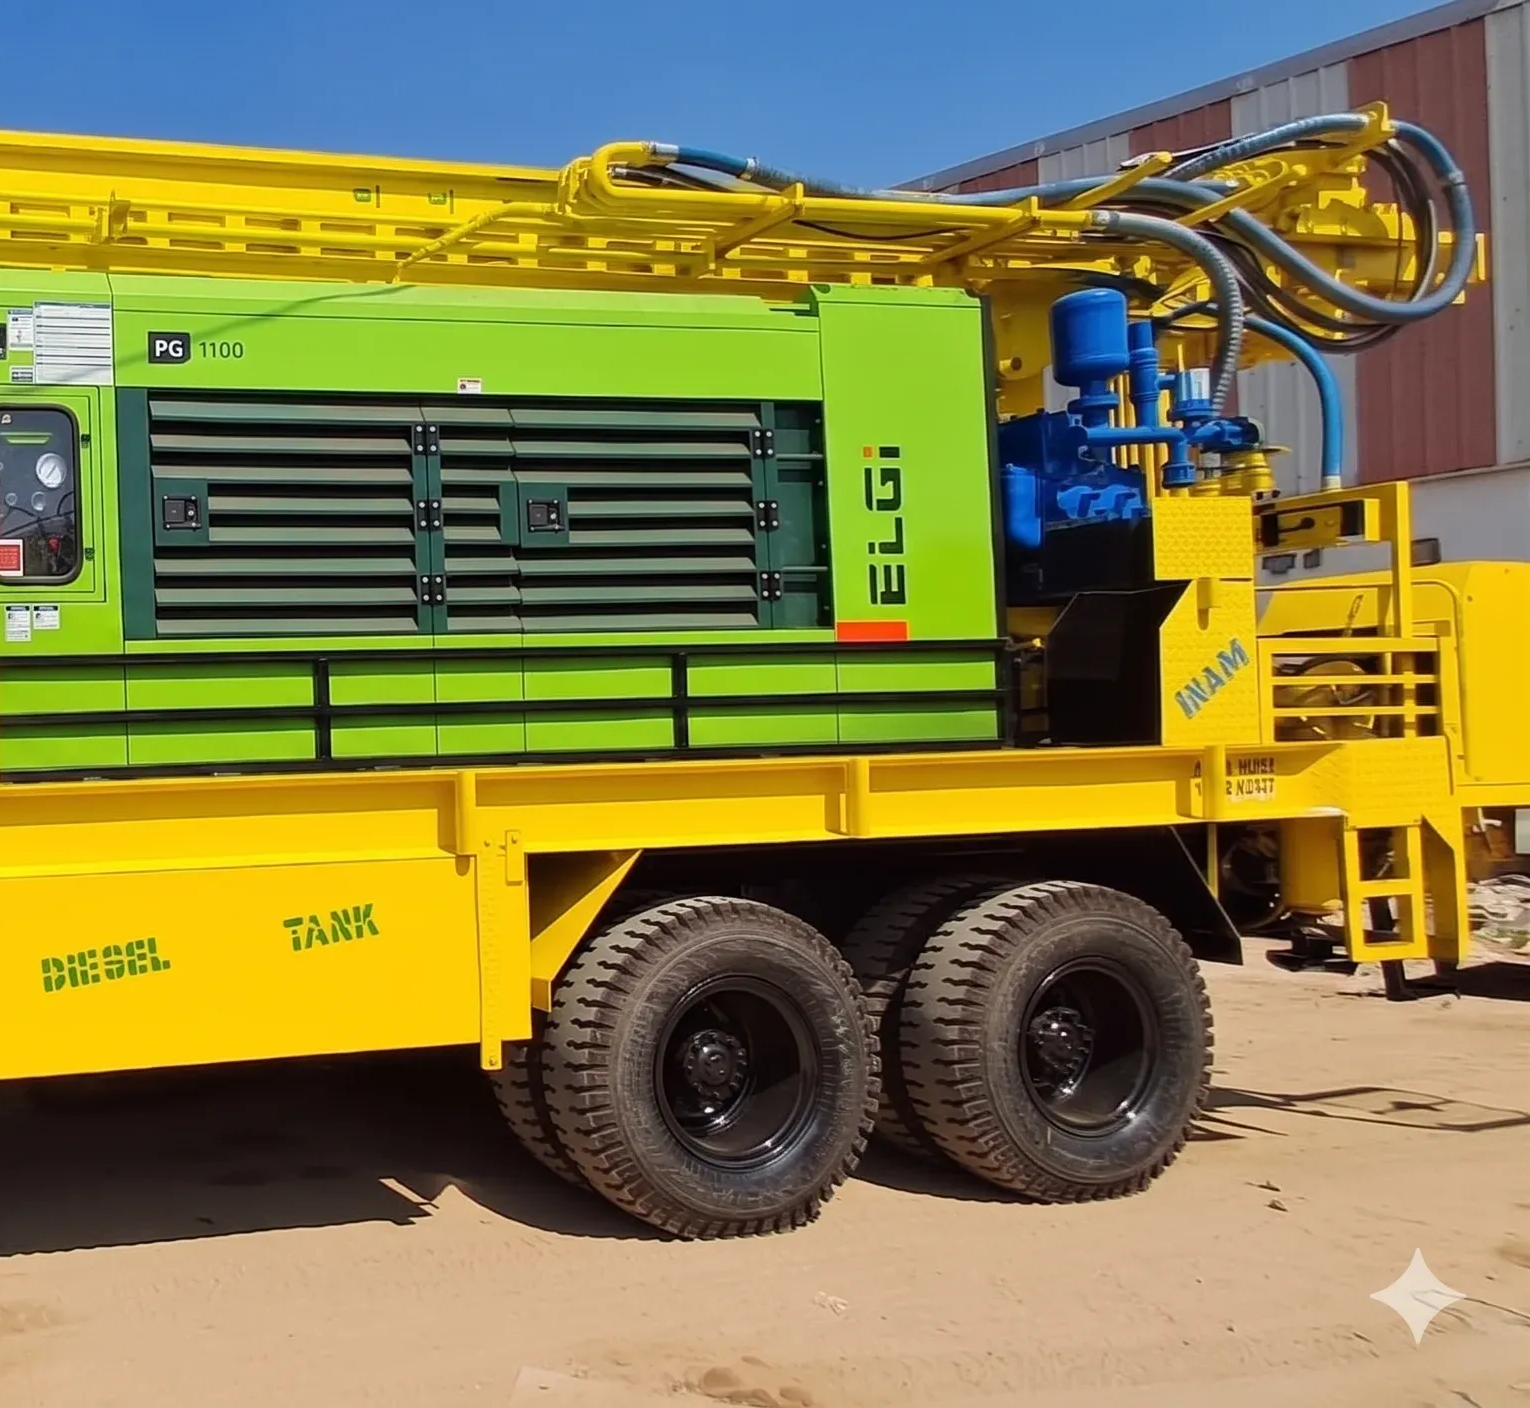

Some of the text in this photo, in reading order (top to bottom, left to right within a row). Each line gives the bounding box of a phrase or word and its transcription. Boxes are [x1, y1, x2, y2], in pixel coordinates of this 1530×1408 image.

[155, 339, 244, 359] PG 1100
[41, 903, 380, 993] DIESEL TANK
